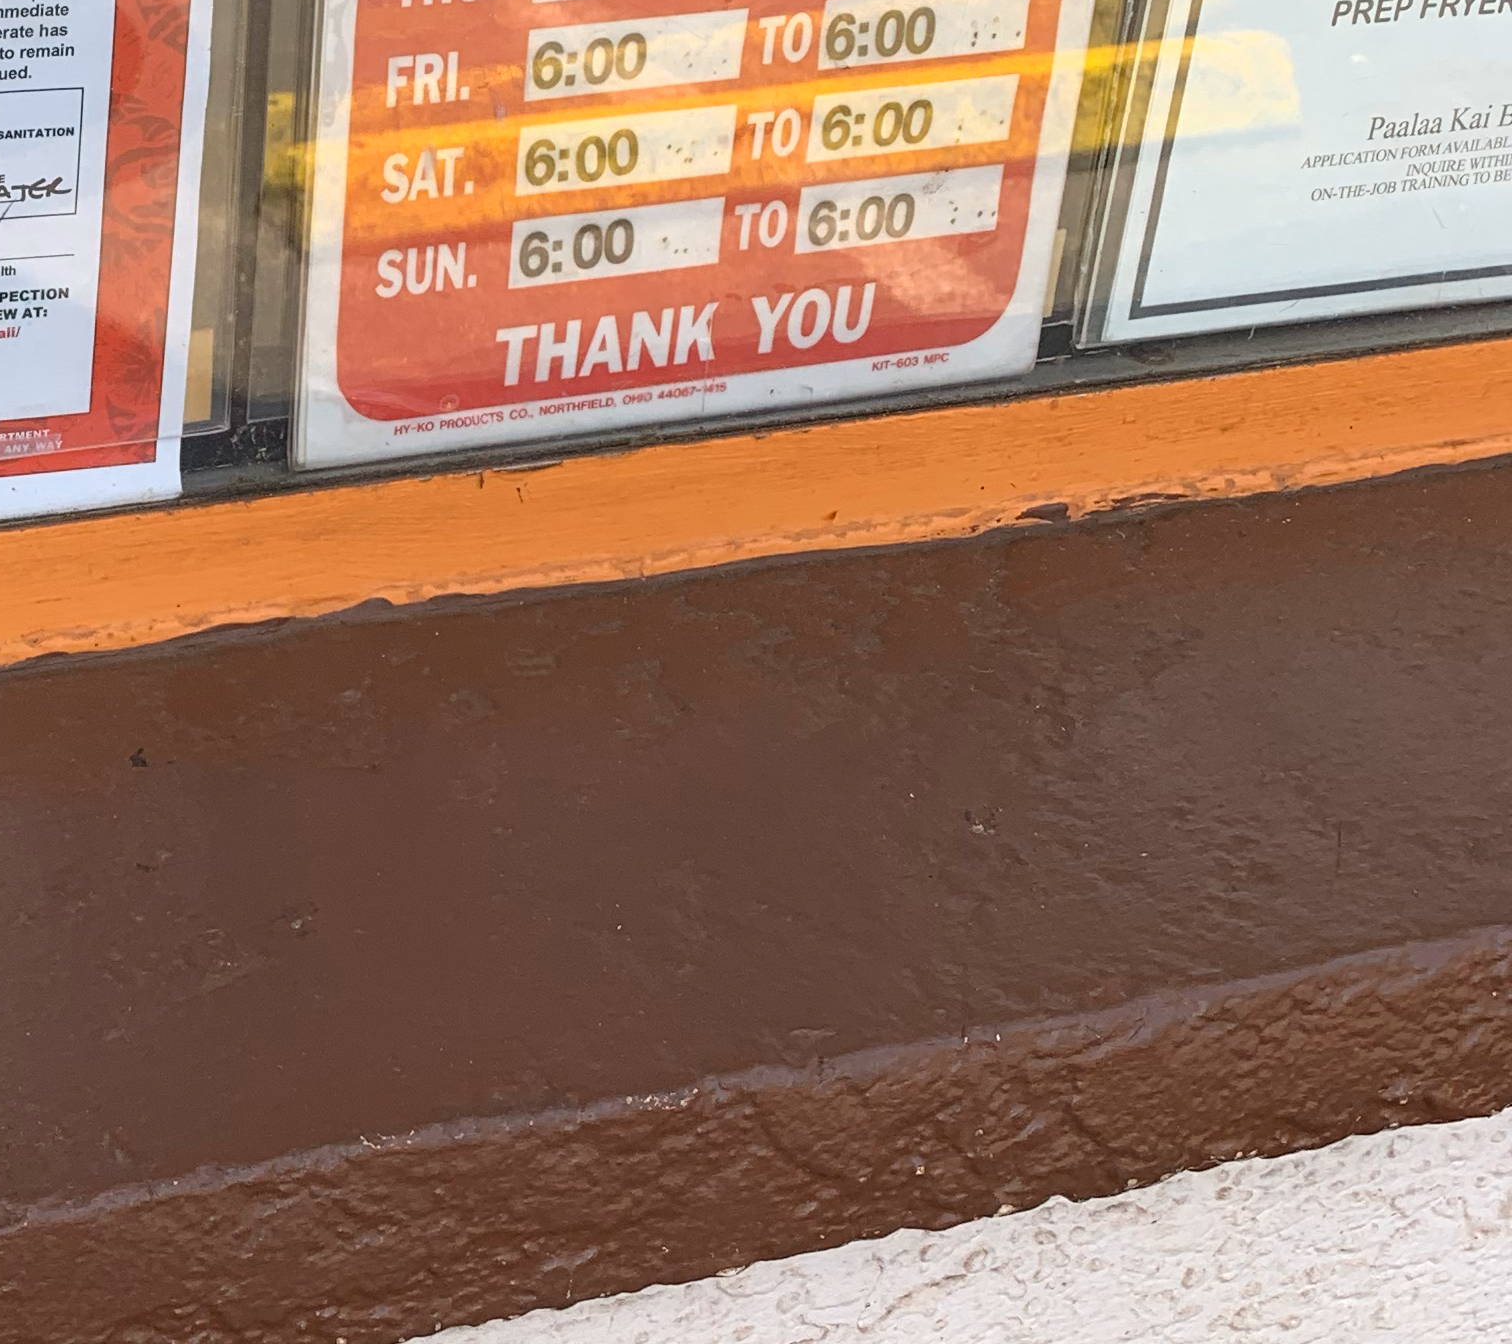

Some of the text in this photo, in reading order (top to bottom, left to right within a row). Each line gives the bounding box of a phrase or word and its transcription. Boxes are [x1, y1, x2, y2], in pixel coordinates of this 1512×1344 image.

[386, 7, 937, 109] FRI. 6:00 TO 6:00
[1367, 105, 1493, 140] Paalaa Kai
[381, 99, 934, 204] SAT. 6:00 TO 6:00
[1301, 148, 1399, 169] APPLICATION
[1400, 143, 1441, 159] FORM
[1406, 159, 1466, 177] INQUIRE
[1311, 181, 1396, 201] ON-THE-JOB
[1401, 174, 1469, 192] TRAINING
[1473, 172, 1490, 184] TO
[375, 193, 916, 298] SUN. 6:00 TO 6:00
[22, 307, 47, 319] AT:
[496, 283, 877, 388] THANK YOU
[872, 353, 950, 373] KIT-603 MPC
[394, 422, 435, 437] HY-KO
[439, 412, 505, 432] PRODUCTS
[623, 392, 653, 405] OHIO
